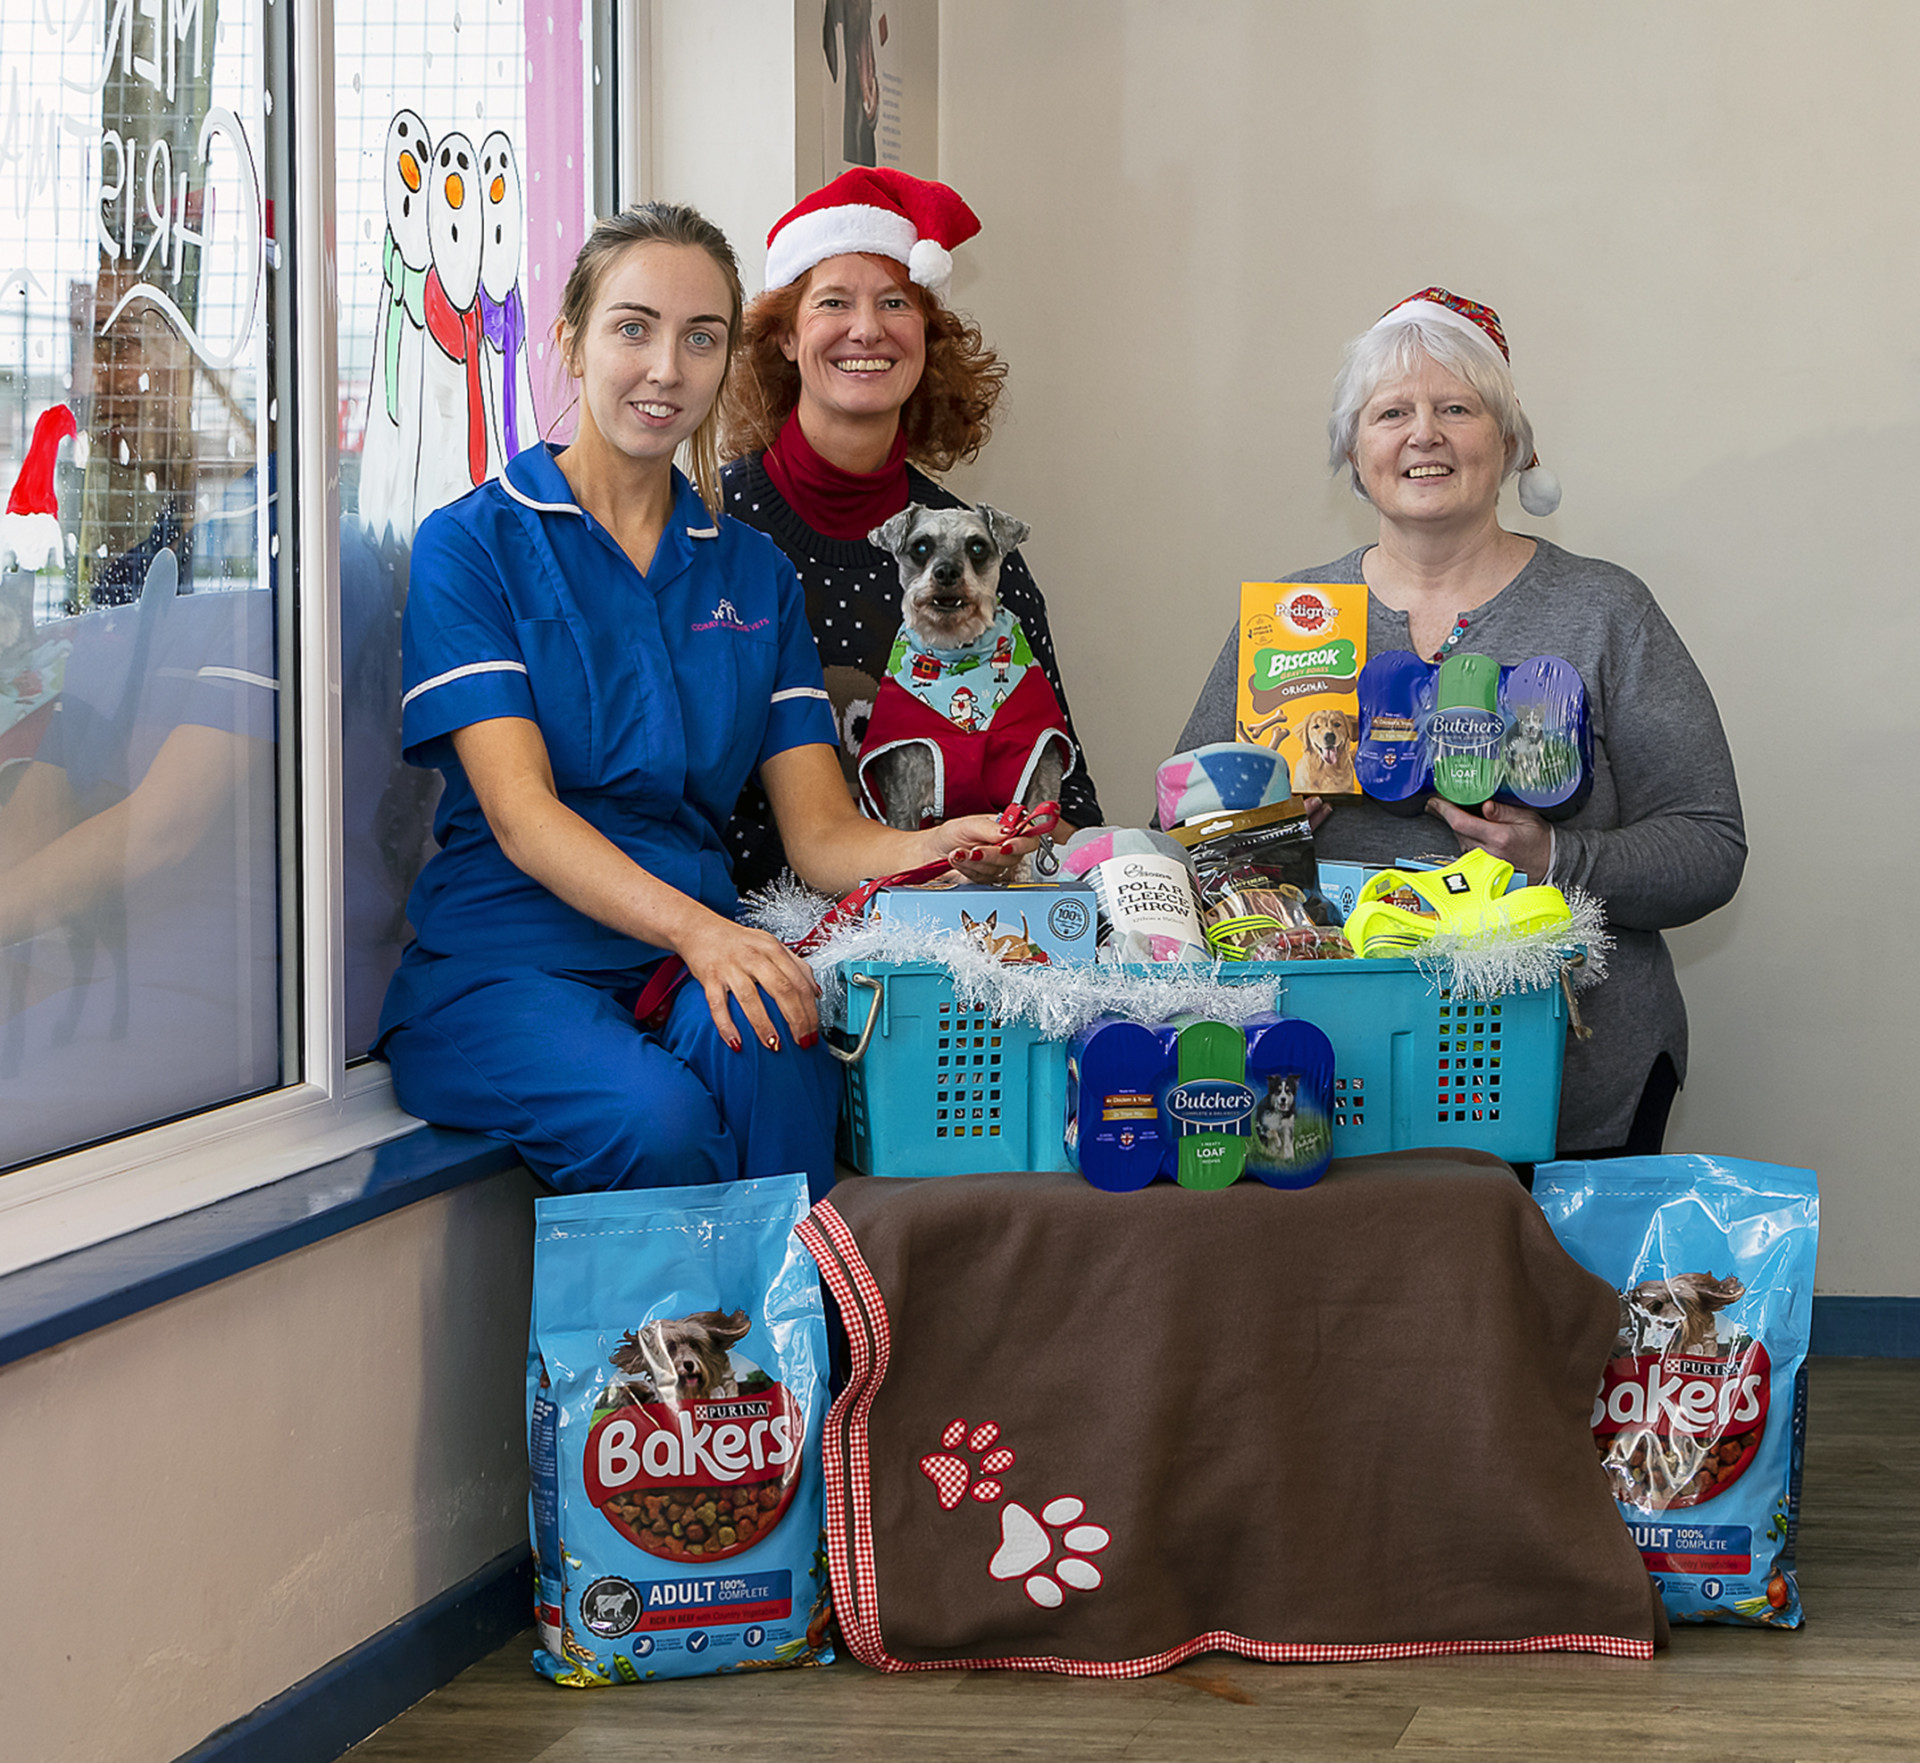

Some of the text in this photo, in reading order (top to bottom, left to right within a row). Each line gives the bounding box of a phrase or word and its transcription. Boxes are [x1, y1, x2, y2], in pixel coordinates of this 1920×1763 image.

[1274, 604, 1339, 619] Pedigree
[1268, 649, 1340, 678] BISCROK
[1280, 666, 1329, 680] GRAVY BONES
[1281, 681, 1329, 696] ORIGINAL
[1432, 714, 1503, 735] Butcher's
[1450, 768, 1477, 778] LOAF
[1118, 881, 1184, 898] POLAR
[1117, 891, 1190, 910] FLEECE
[1120, 902, 1191, 918] THROW
[1173, 1089, 1252, 1110] Butcher's
[1196, 1147, 1226, 1159] LOAF
[708, 1404, 767, 1419] PURINA
[598, 1410, 795, 1488] Bakers
[1628, 1527, 1704, 1548] ULT 100%
[1675, 1539, 1728, 1550] COMPLETE
[649, 1579, 747, 1606] ADULT 100%
[718, 1586, 769, 1601] COMPLETE
[649, 1608, 779, 1625] RICH IN BEEF with Country Vegetables
